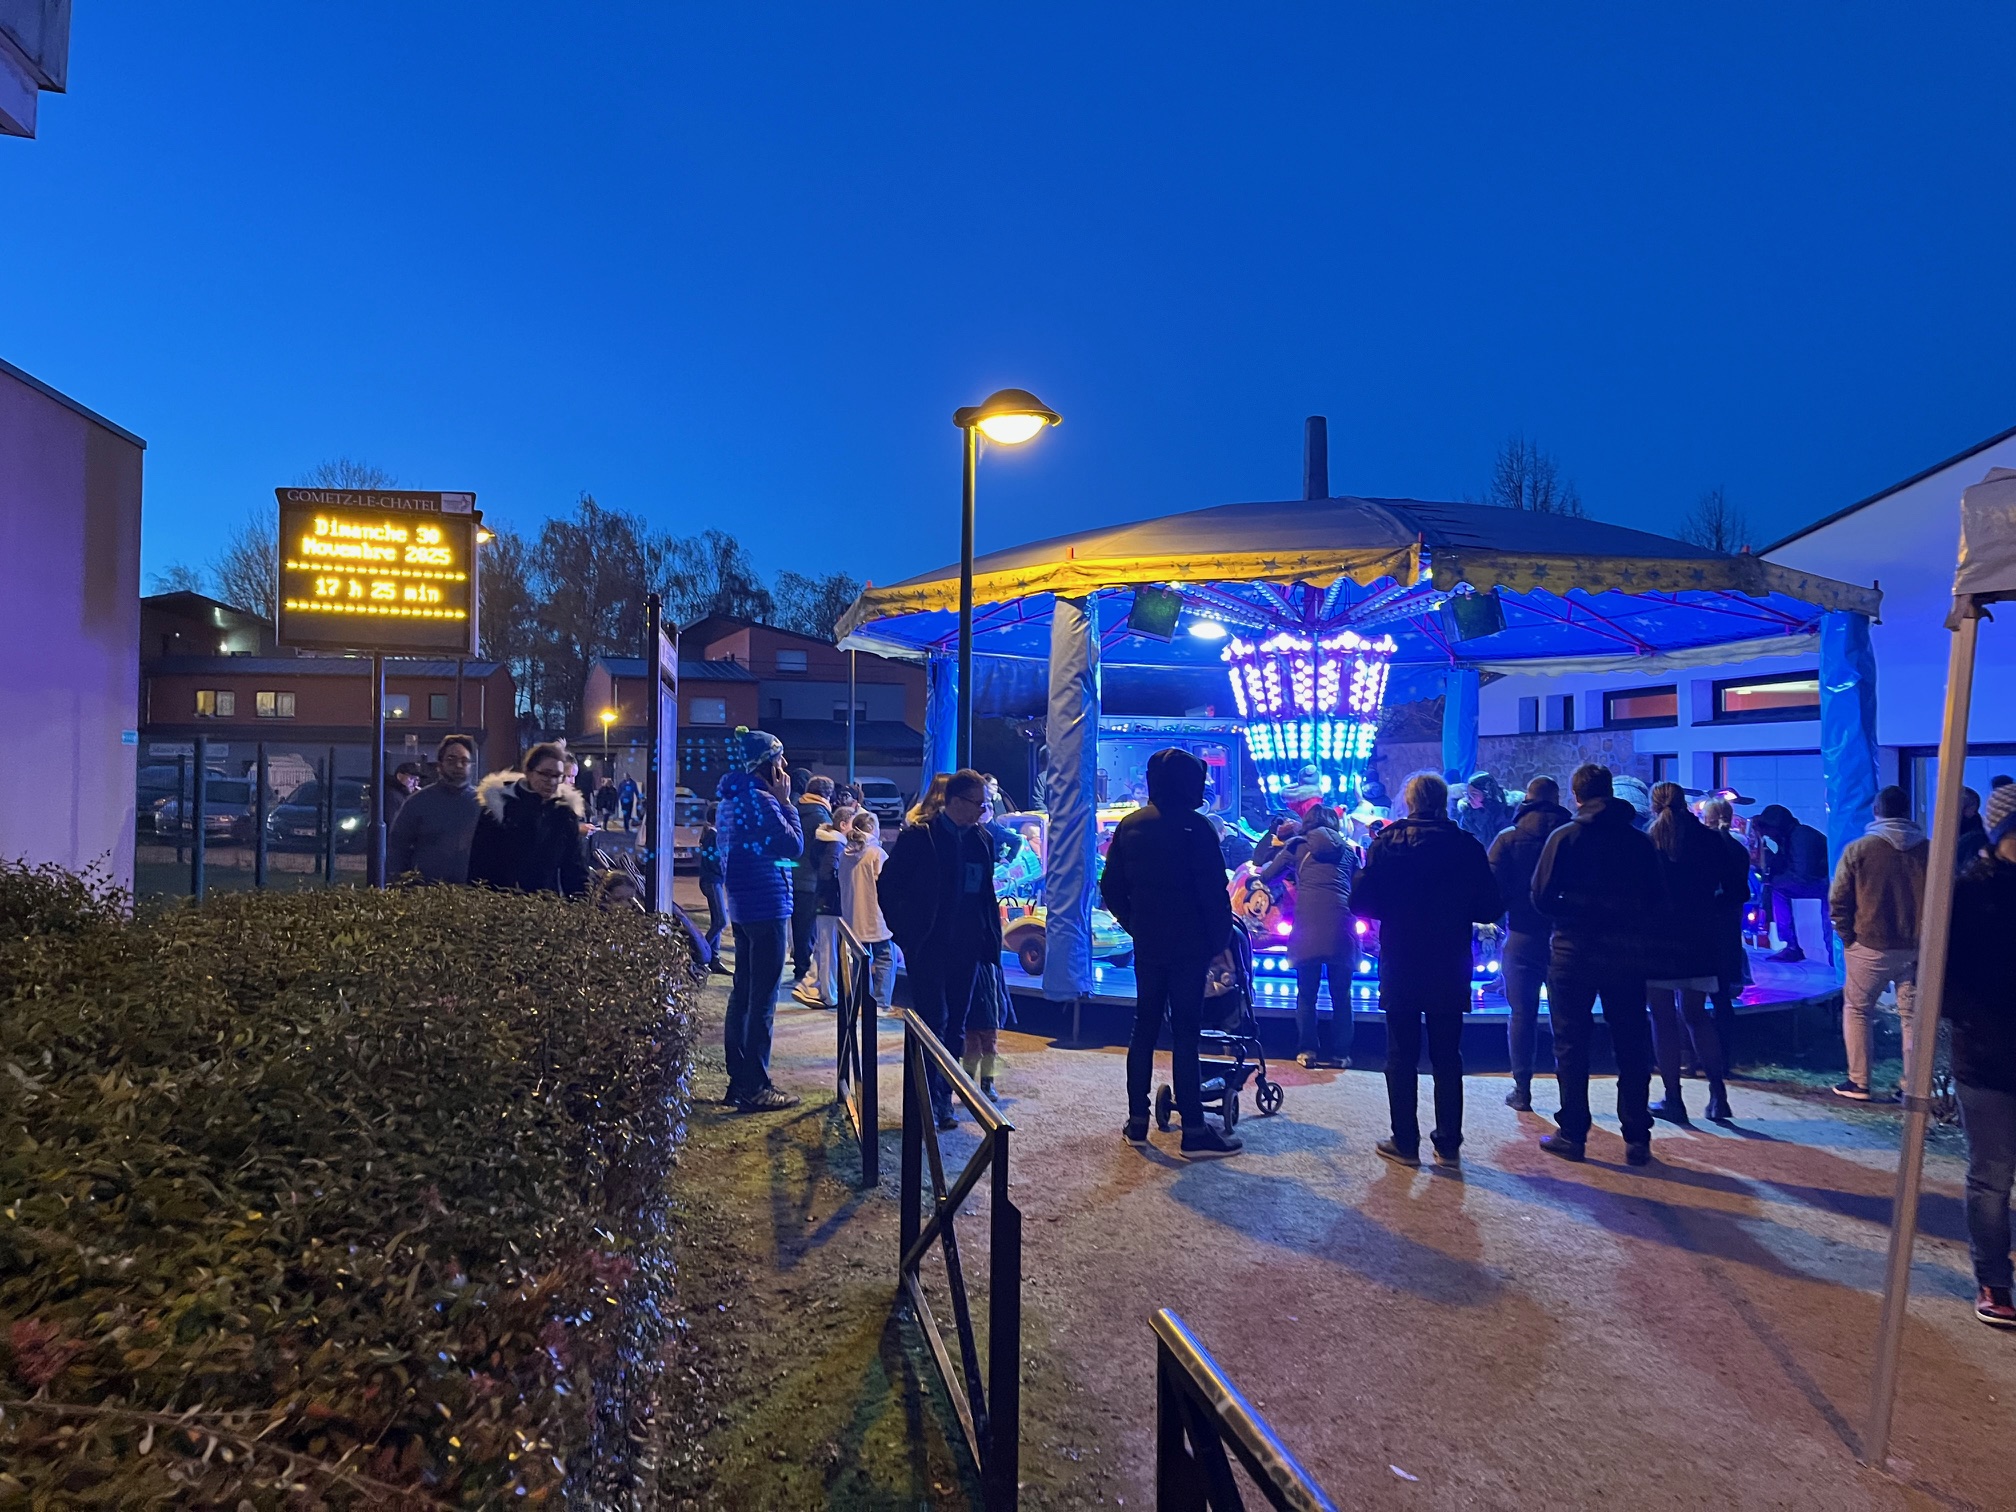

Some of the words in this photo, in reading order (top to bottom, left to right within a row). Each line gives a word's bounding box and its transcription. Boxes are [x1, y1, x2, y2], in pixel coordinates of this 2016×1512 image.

[287, 489, 438, 511] GOMETZ-LE-CHATEL
[313, 516, 407, 543] Dimanche
[416, 525, 441, 545] 30
[302, 537, 396, 562] Novembre
[404, 546, 451, 565] 2025
[315, 577, 340, 597] 17
[348, 578, 363, 598] h
[370, 581, 396, 601] 25
[404, 582, 441, 603] min
